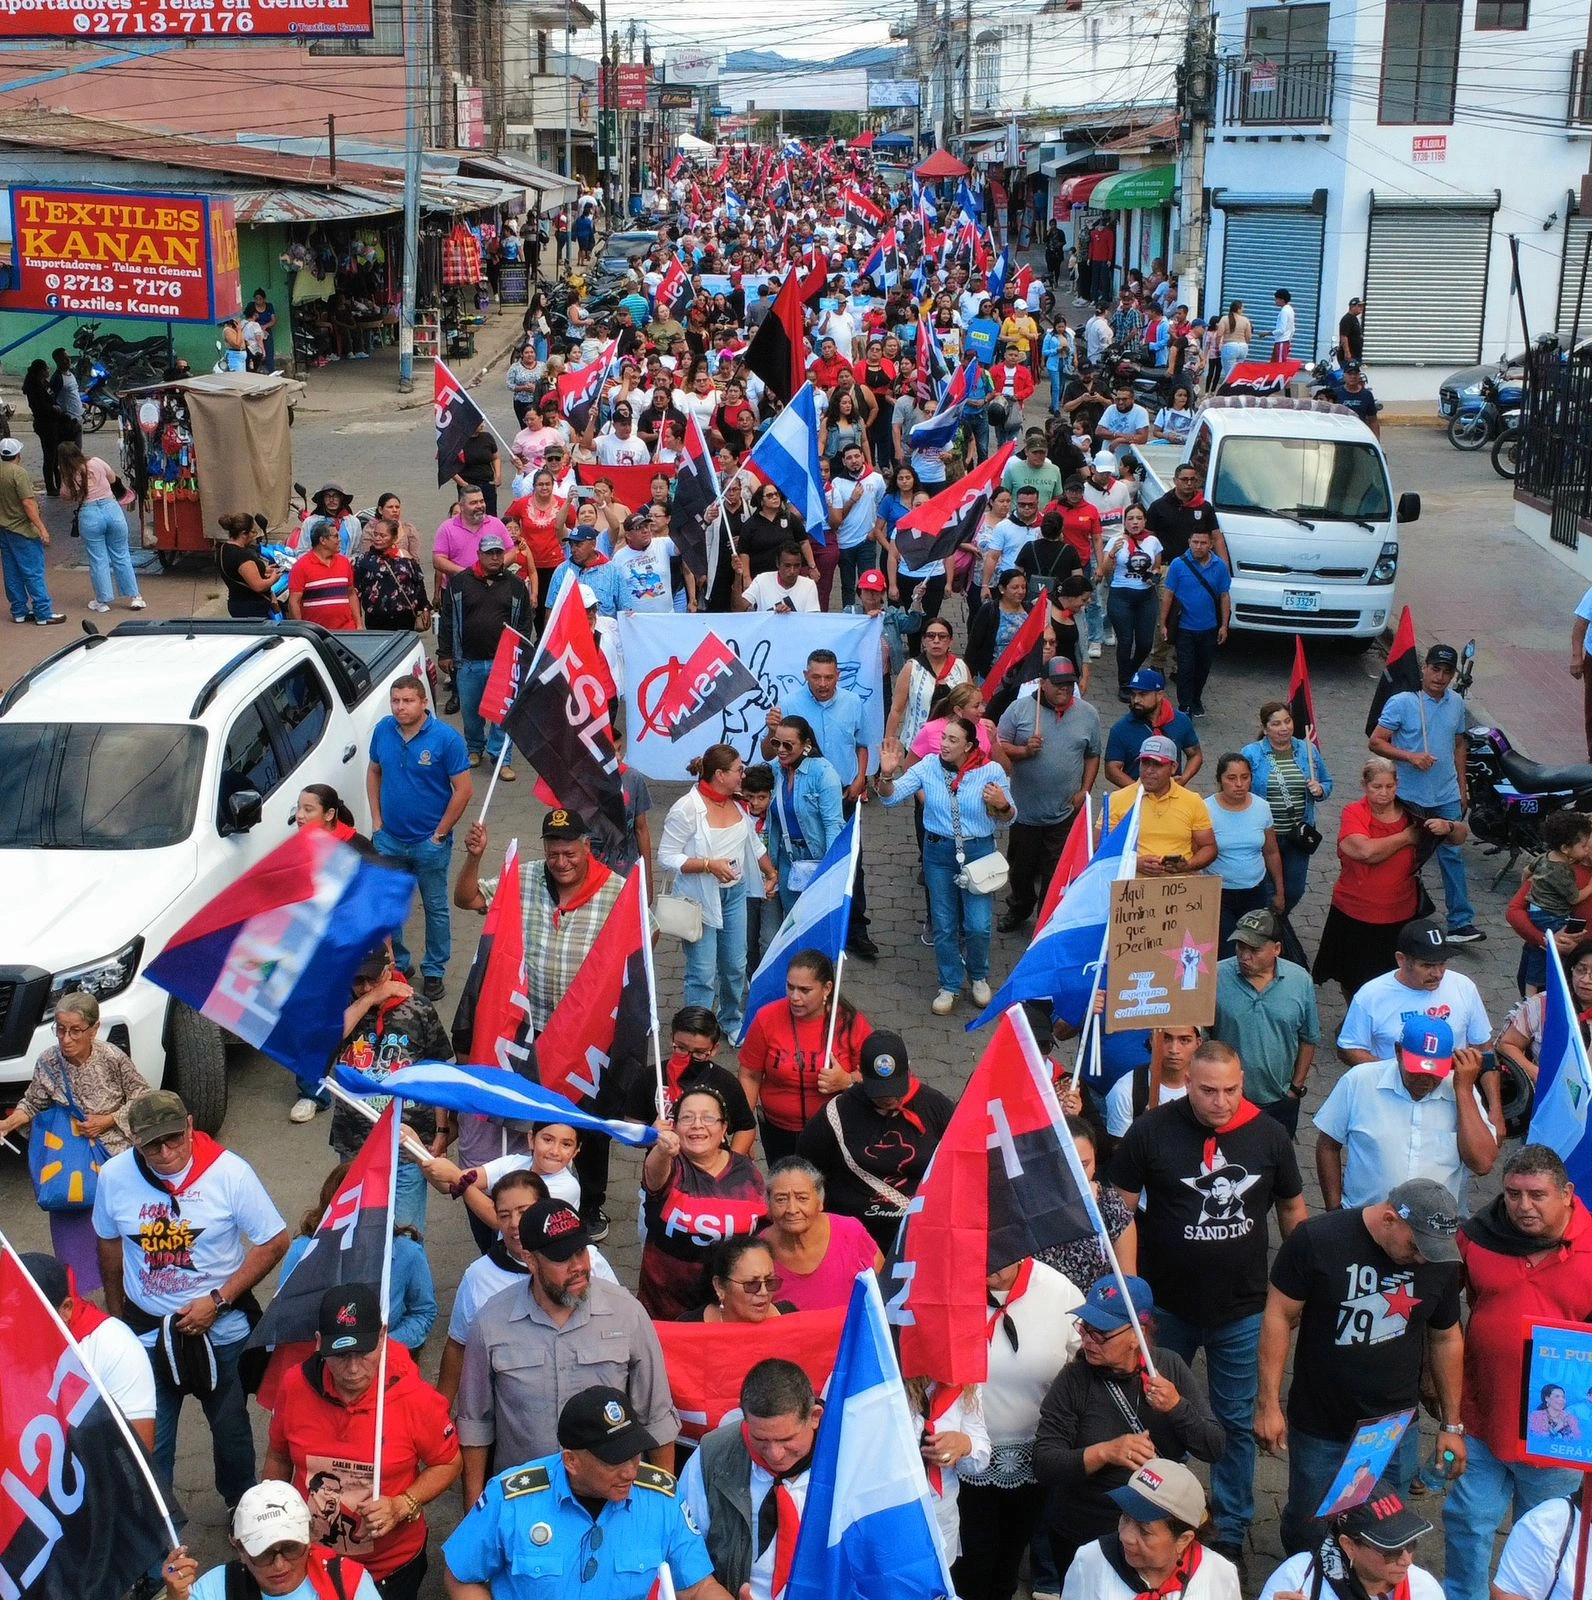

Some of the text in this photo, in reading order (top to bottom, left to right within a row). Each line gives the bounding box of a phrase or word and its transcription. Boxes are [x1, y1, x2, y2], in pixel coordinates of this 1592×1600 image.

[93, 12, 254, 33] 2713-7176
[20, 196, 200, 232] TEXTILES
[848, 200, 879, 226] FSLN
[20, 228, 200, 267] KANAN
[25, 257, 102, 271] Importadores
[112, 263, 141, 274] Telas
[143, 267, 157, 275] en
[159, 267, 202, 278] General
[63, 274, 114, 291] 2713
[133, 278, 182, 298] 7176
[61, 295, 123, 312] Textiles
[127, 299, 180, 316] Kanan
[1285, 596, 1295, 606] ES
[538, 641, 619, 776] FSL
[1162, 882, 1187, 897] nos
[1115, 894, 1203, 924] ilumina un sol
[1126, 919, 1177, 942] que no
[1114, 936, 1163, 961] Declina
[1120, 988, 1167, 1000] Esperanza
[1115, 1004, 1169, 1018] Solidaridad
[140, 1218, 192, 1237] NO SE
[1183, 1217, 1254, 1241] SANDINO
[141, 1235, 195, 1253] RINDE
[1345, 1263, 1378, 1300] 19
[1337, 1305, 1374, 1345] 79
[1539, 1346, 1560, 1359] EL
[332, 1460, 351, 1469] CARLOS
[1140, 1470, 1160, 1489] FSLN
[257, 1509, 281, 1522] PUMA
